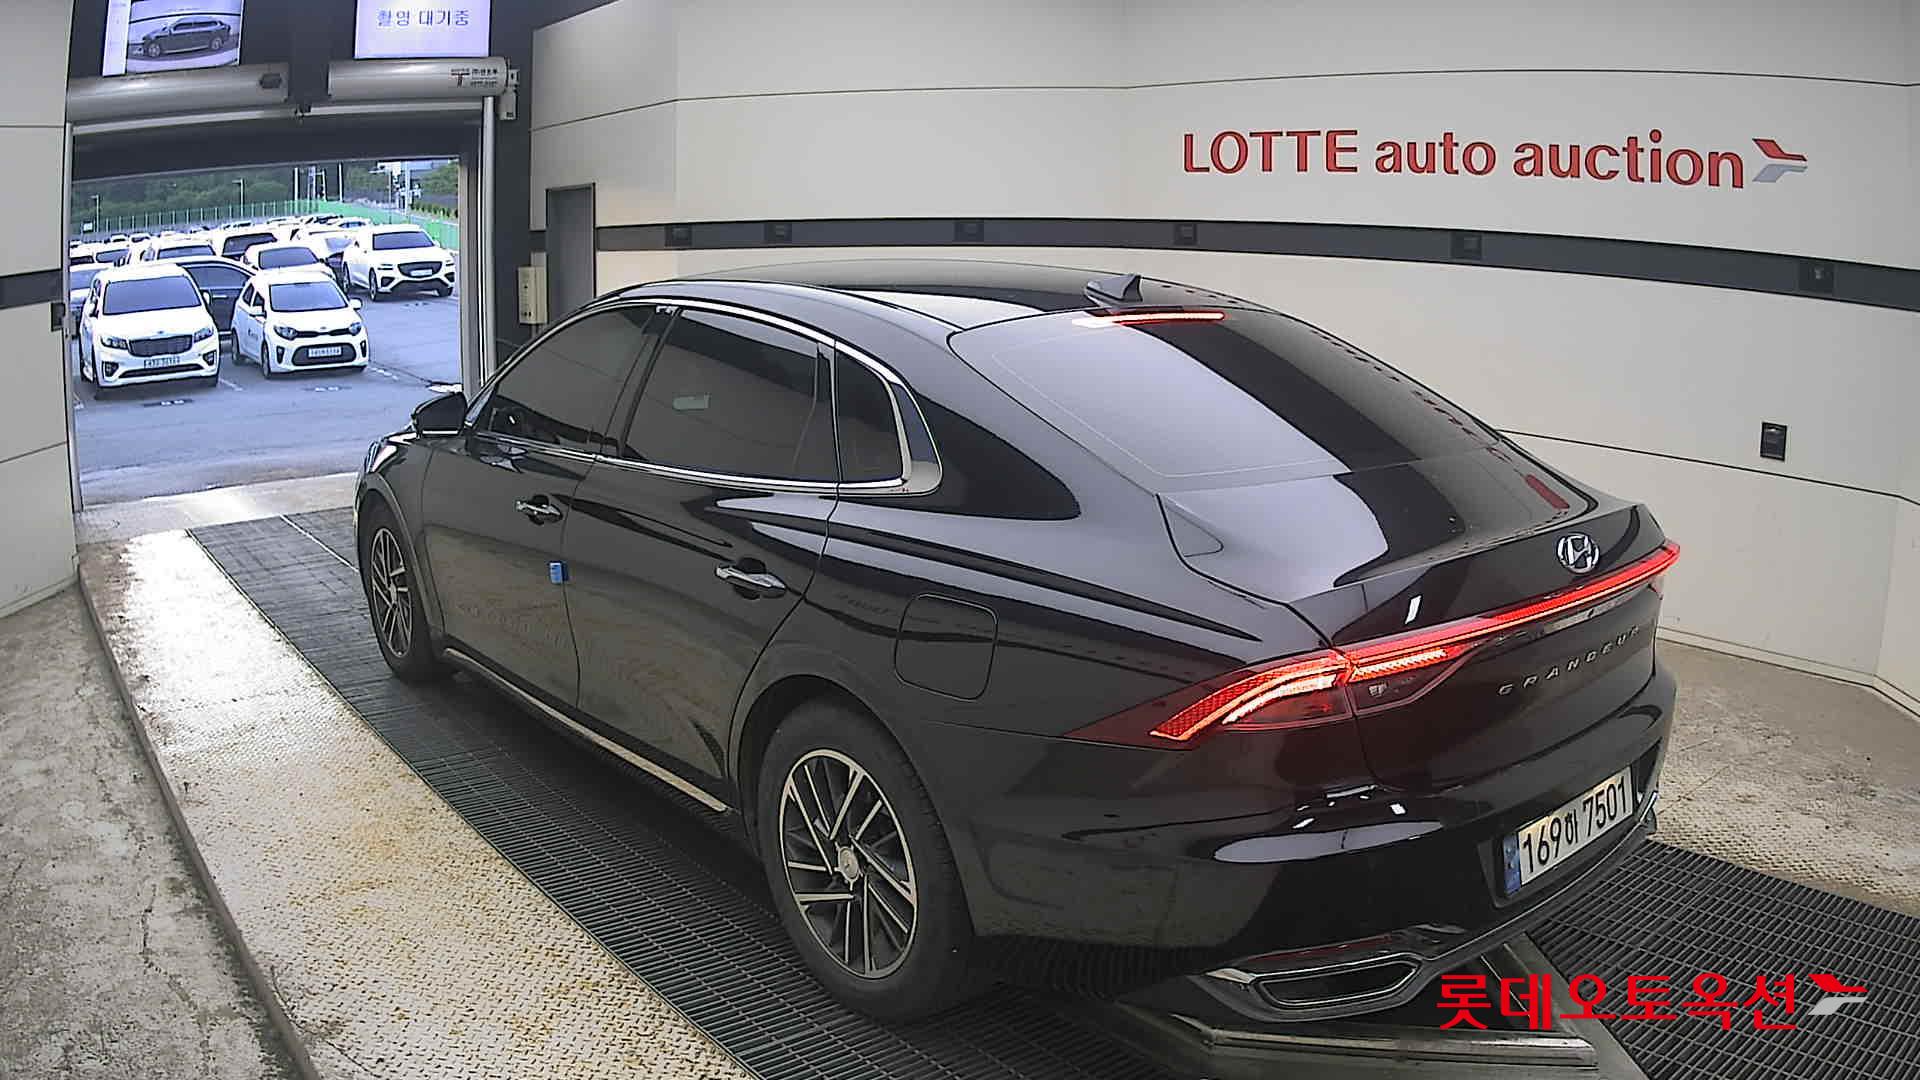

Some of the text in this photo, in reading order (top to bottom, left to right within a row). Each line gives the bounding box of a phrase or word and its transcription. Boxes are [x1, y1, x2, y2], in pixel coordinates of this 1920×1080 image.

[418, 9, 469, 27] 대기중
[1183, 129, 1744, 188] LOTTE auto auction
[1498, 625, 1640, 696] GRANDEUR
[1582, 775, 1626, 838] 7501
